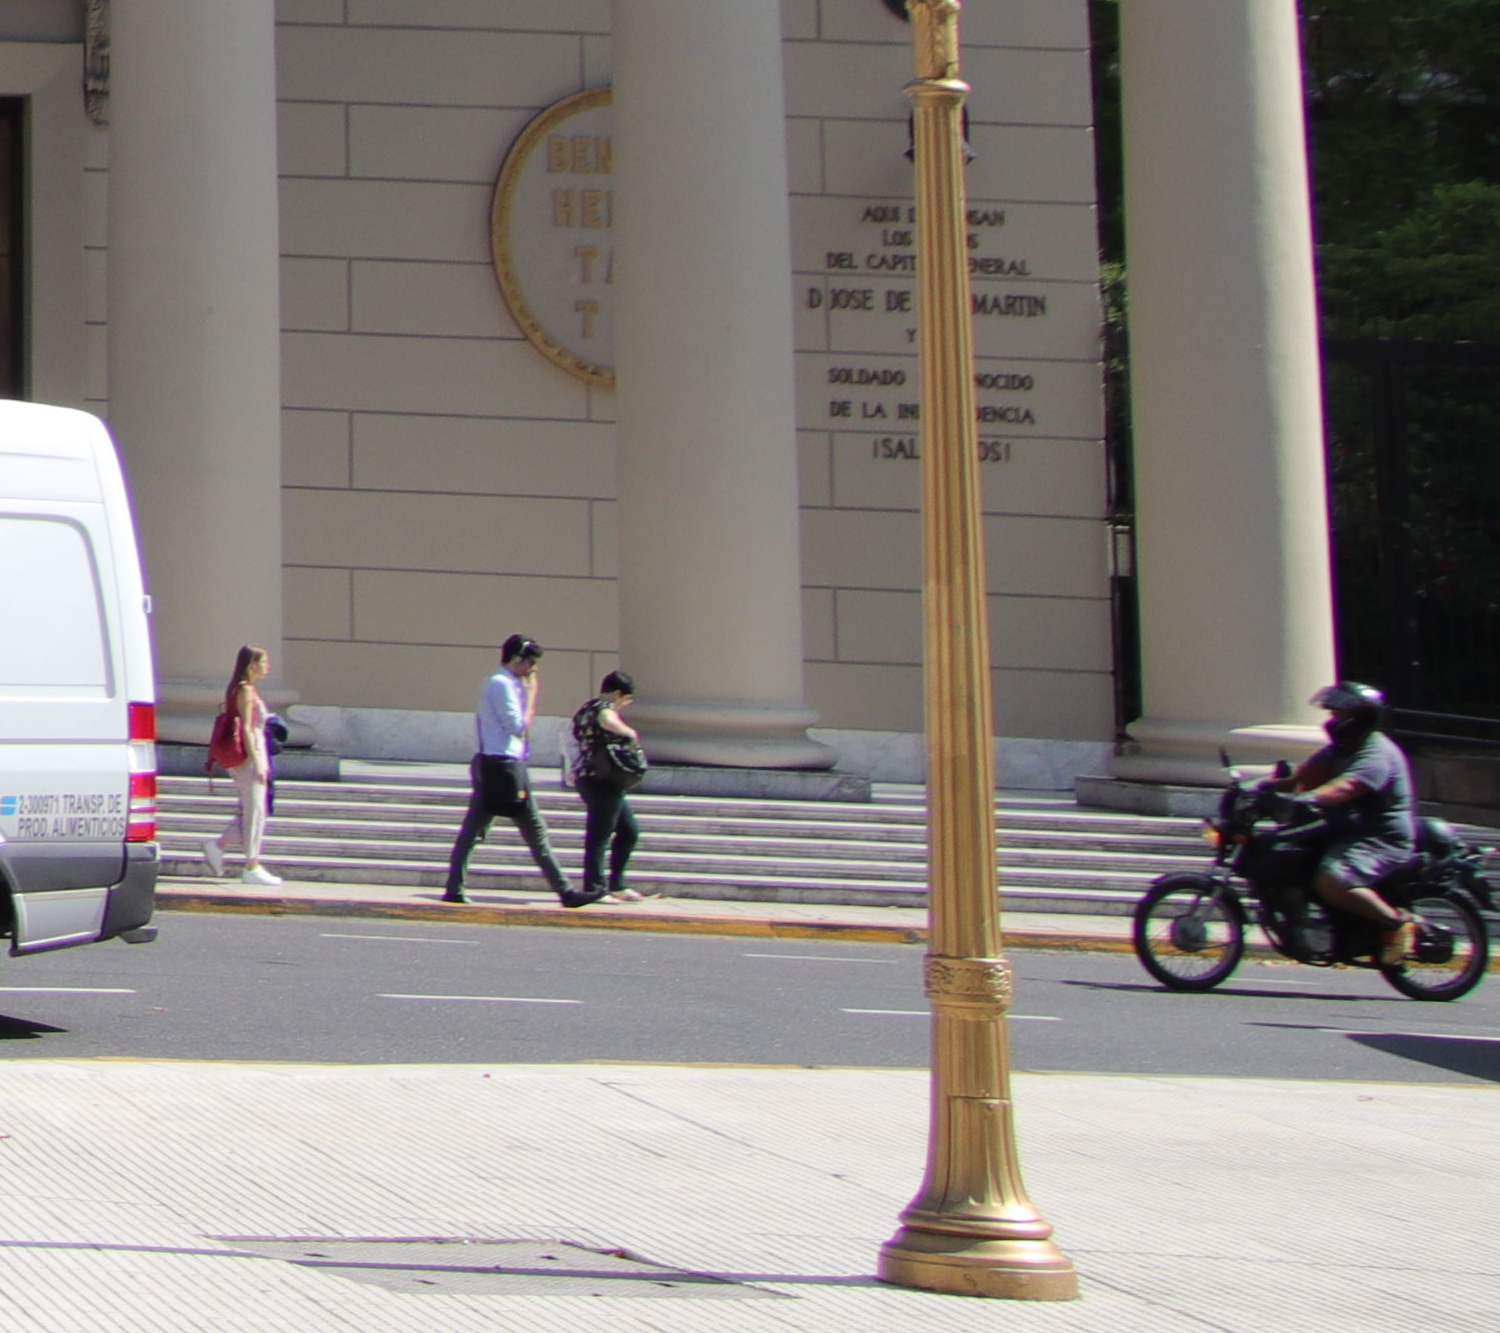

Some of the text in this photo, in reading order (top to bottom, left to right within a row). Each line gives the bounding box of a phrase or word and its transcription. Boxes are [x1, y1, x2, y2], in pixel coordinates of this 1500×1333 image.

[861, 206, 900, 223] AQUI
[882, 230, 913, 247] LOS
[826, 252, 858, 270] DEL
[828, 287, 875, 312] JOSE
[885, 289, 913, 313] DE
[970, 294, 1047, 318] MARTIN
[828, 368, 907, 387] SOLDADO
[829, 401, 852, 418] DE
[862, 402, 888, 419] LA
[63, 794, 106, 815] TRANSP.
[108, 794, 122, 814] DE
[18, 817, 125, 838] PROD. ALIMENTICIOS
